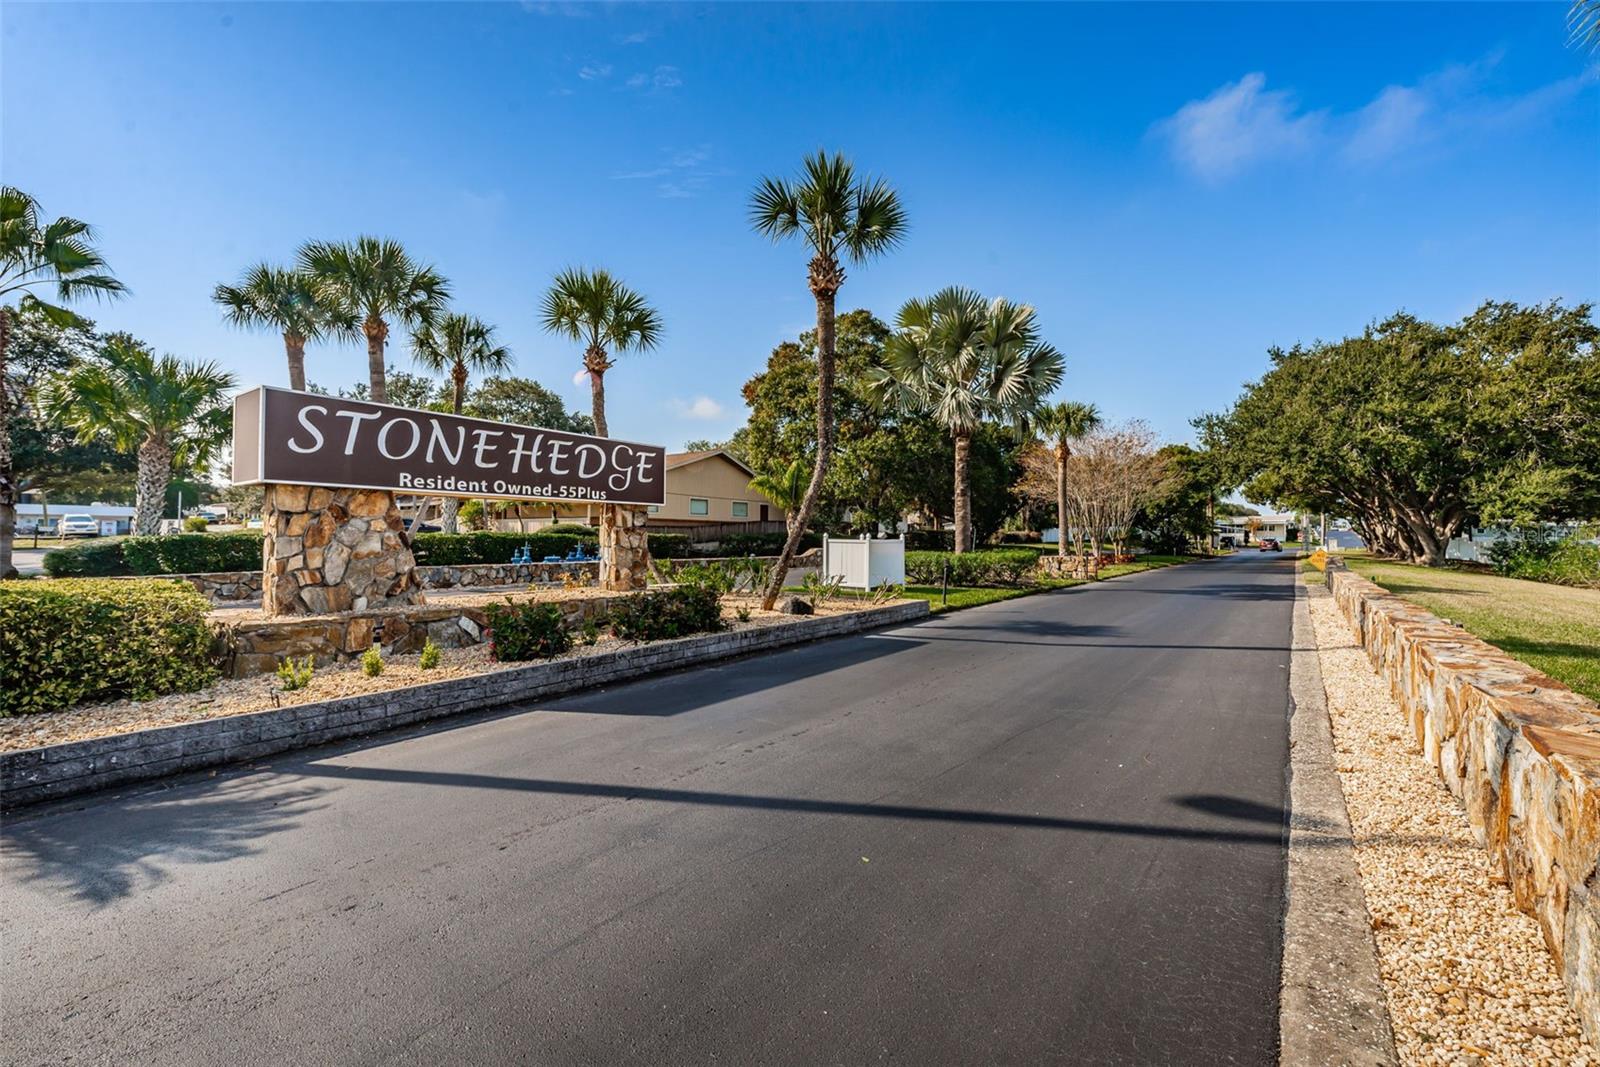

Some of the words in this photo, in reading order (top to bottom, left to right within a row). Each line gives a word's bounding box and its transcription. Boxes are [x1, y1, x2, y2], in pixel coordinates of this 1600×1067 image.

[287, 405, 657, 491] STONEHEDGE
[399, 472, 488, 492] Resident
[493, 480, 607, 500] Owned-55Plus
